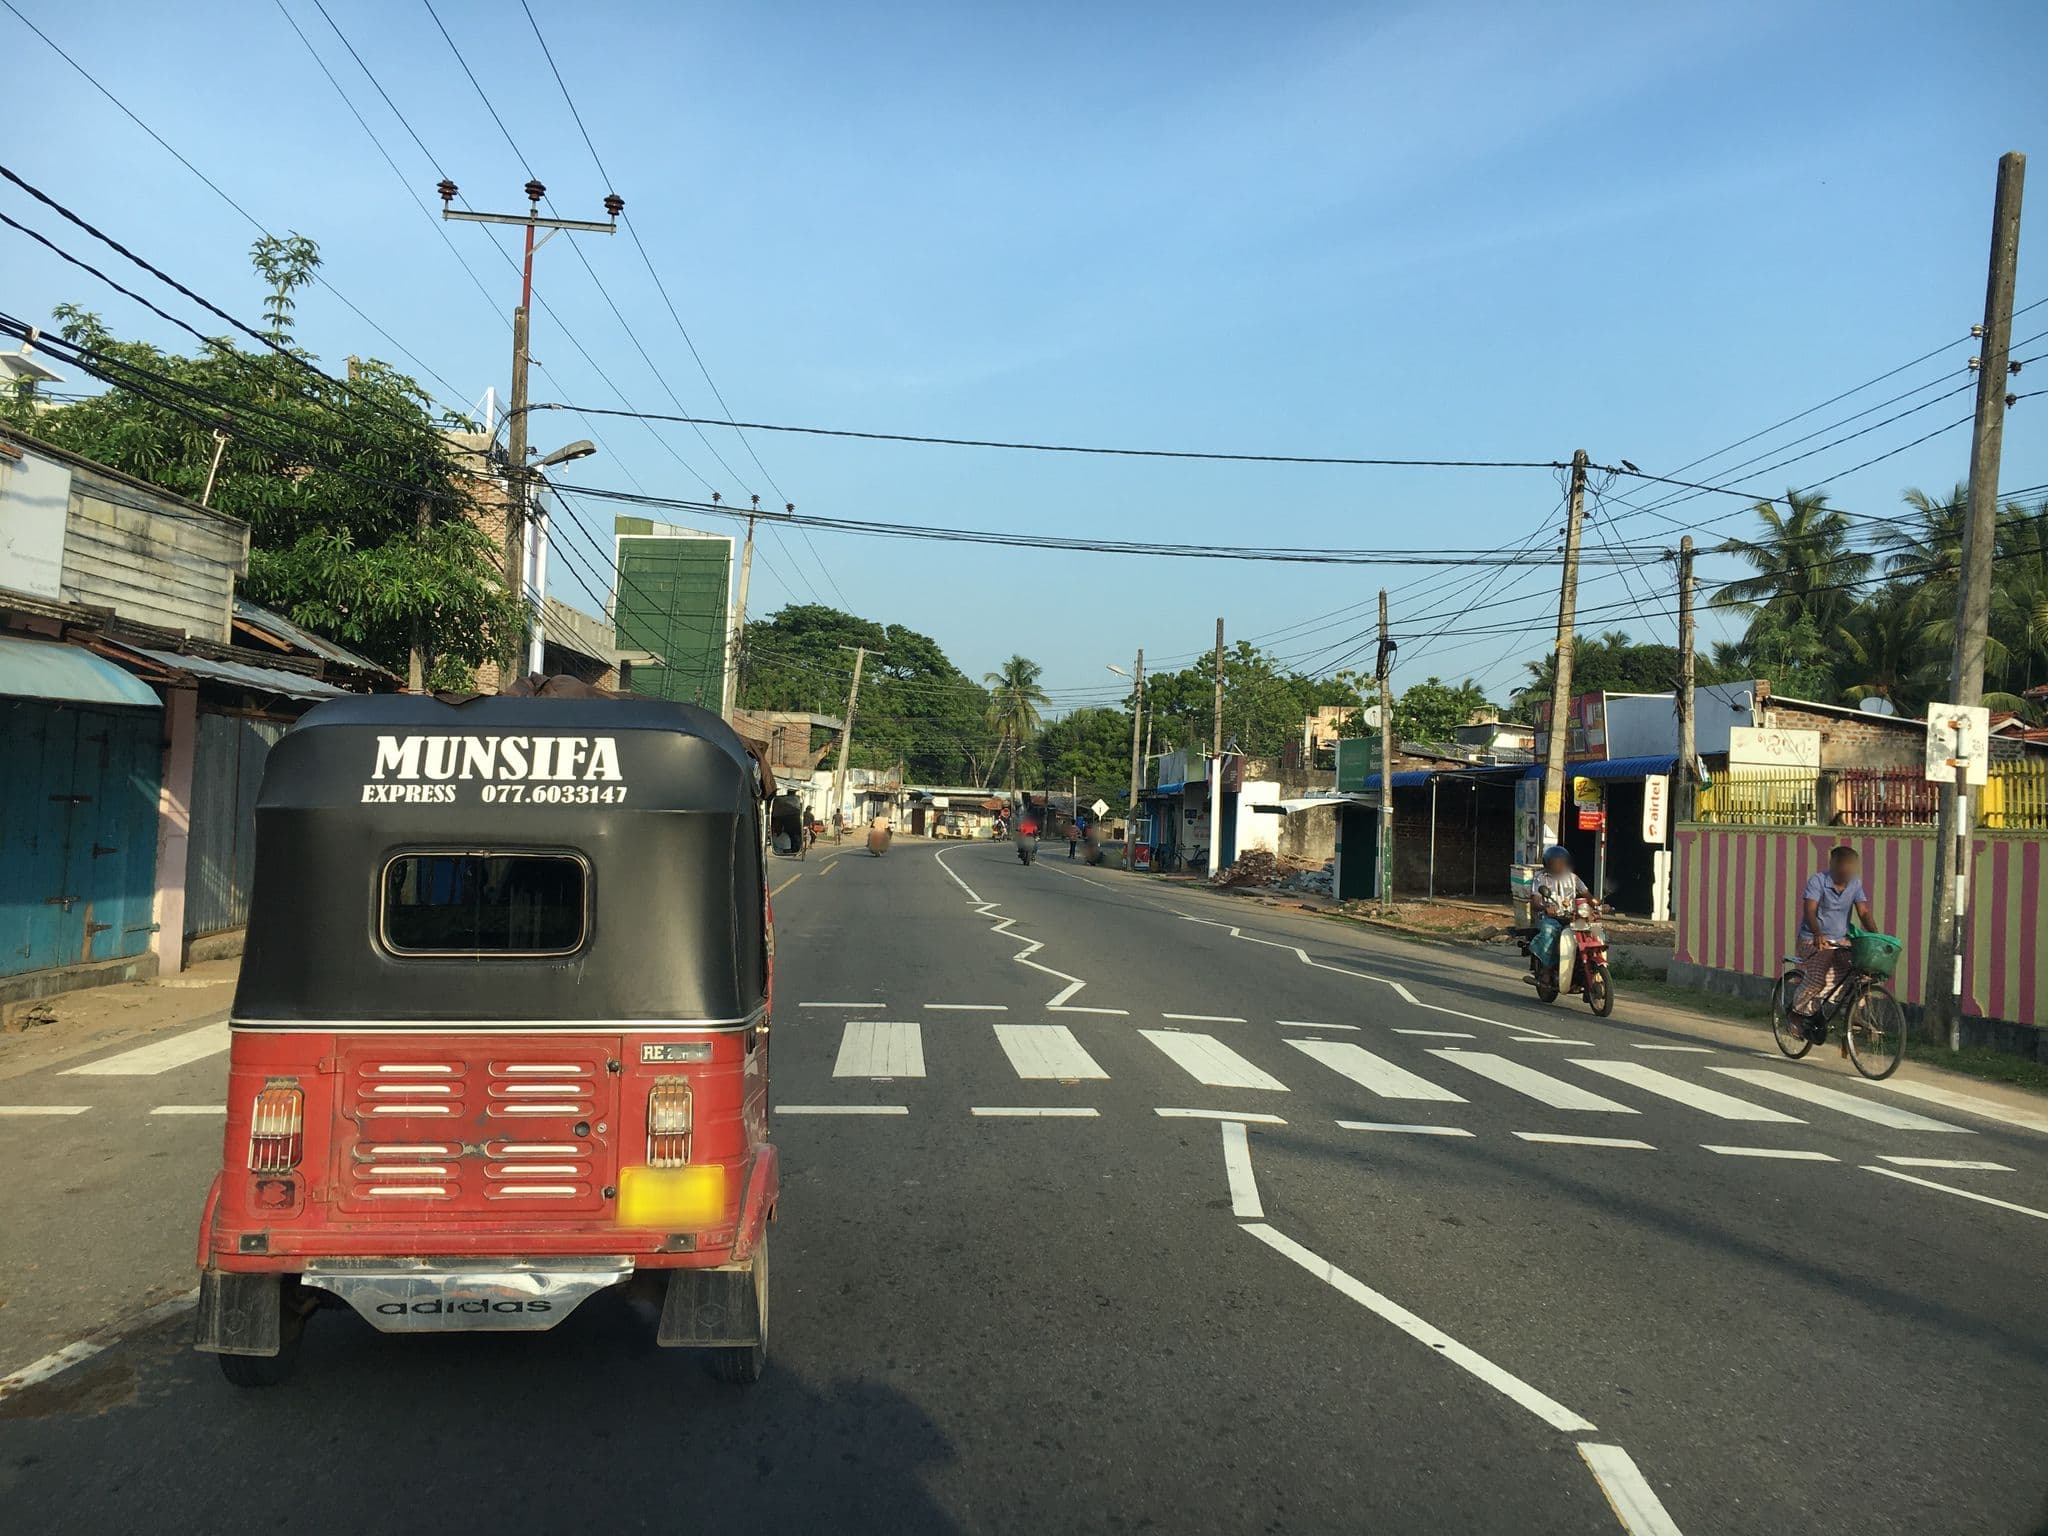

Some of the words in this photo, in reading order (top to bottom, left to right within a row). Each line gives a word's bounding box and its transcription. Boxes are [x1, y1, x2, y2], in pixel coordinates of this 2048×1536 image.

[371, 735, 624, 781] MUNSIFA
[360, 784, 457, 803] EXPRESS
[481, 784, 628, 804] 077.6033147
[1649, 781, 1661, 821] airtel
[376, 1299, 552, 1315] adidas
